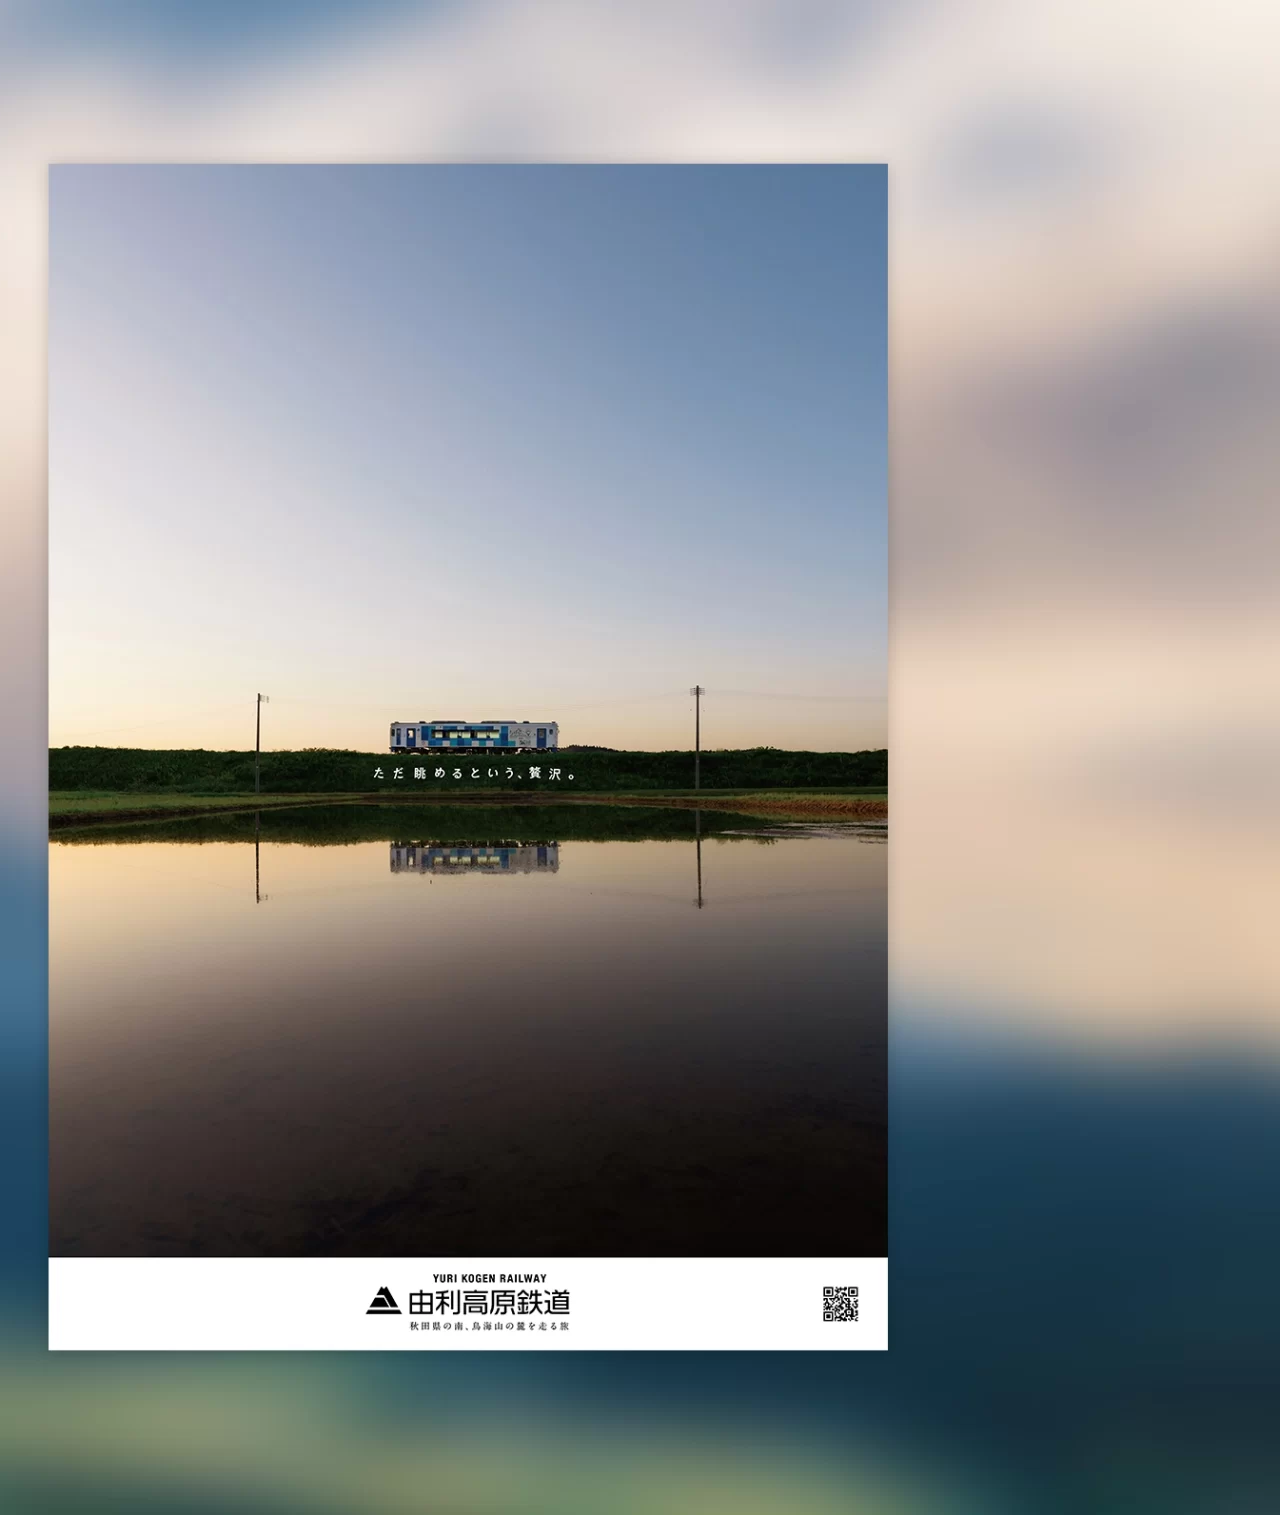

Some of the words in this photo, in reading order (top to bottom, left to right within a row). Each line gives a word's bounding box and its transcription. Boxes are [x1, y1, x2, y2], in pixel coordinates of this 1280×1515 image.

[373, 766, 575, 781] ただ眺めるという、贅沢。
[432, 1273, 458, 1283] YURI
[461, 1273, 496, 1283] KOGEN
[499, 1273, 547, 1283] RAILWAY
[409, 1289, 570, 1315] 由利高原鉄道
[409, 1321, 569, 1331] 秋田県の南、鳥海山の麓を走る旅
